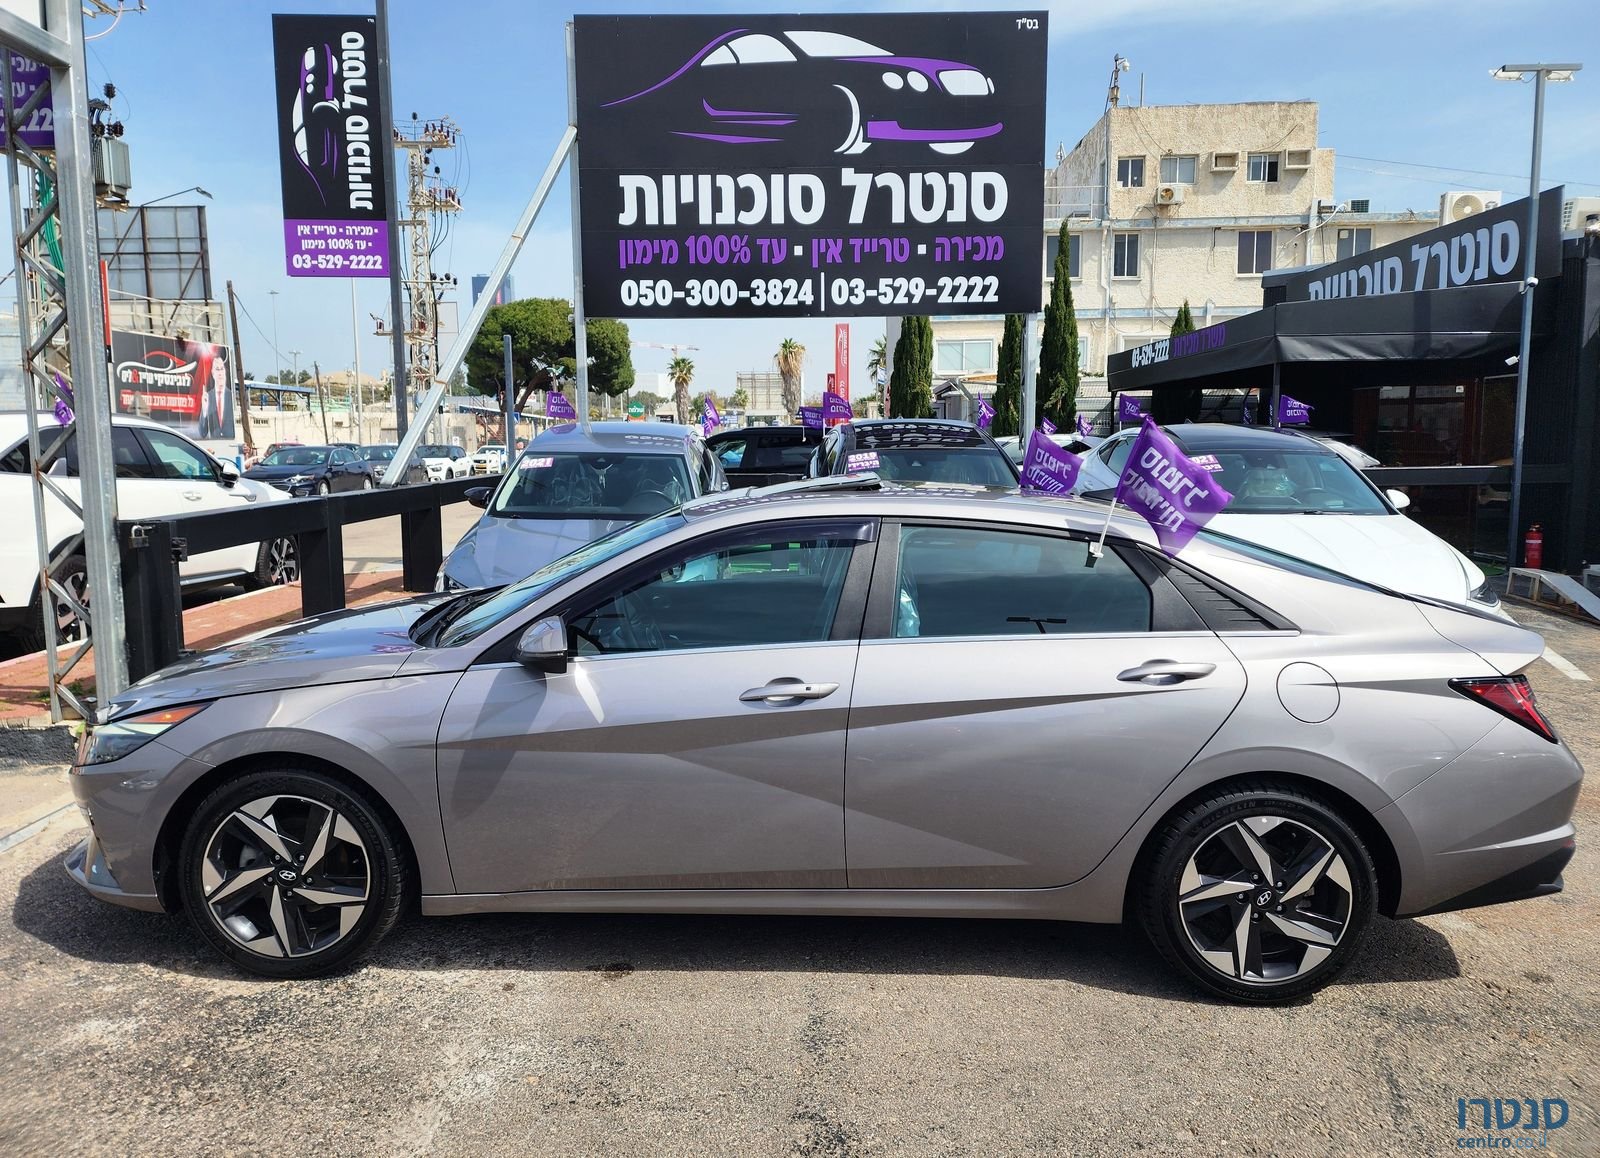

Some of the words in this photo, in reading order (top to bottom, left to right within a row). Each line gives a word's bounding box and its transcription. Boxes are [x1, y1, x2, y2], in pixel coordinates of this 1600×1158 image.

[1016, 17, 1039, 30] בס"ד
[341, 31, 368, 109] סנטרל
[345, 115, 373, 210] סוכנויות
[618, 173, 826, 225] סוכנויות
[841, 167, 1008, 224] סנטרל
[297, 224, 310, 236] אין
[312, 225, 337, 235] טרייד
[327, 238, 354, 250] 100%
[346, 225, 373, 236] מכירה
[301, 239, 325, 250] מימון
[355, 240, 366, 250] עד
[619, 239, 679, 269] מימון
[684, 234, 751, 264] 100%
[756, 238, 787, 265] עד
[811, 238, 843, 268] אין
[849, 237, 910, 263] טרייד
[935, 235, 1005, 262] מכירה
[1411, 219, 1520, 291] סנטרל
[292, 254, 383, 269] 03-529-2222
[620, 278, 814, 307] 050-300-3824
[831, 275, 1000, 305] 03-529-2222
[1131, 339, 1170, 368] 03-529-2222
